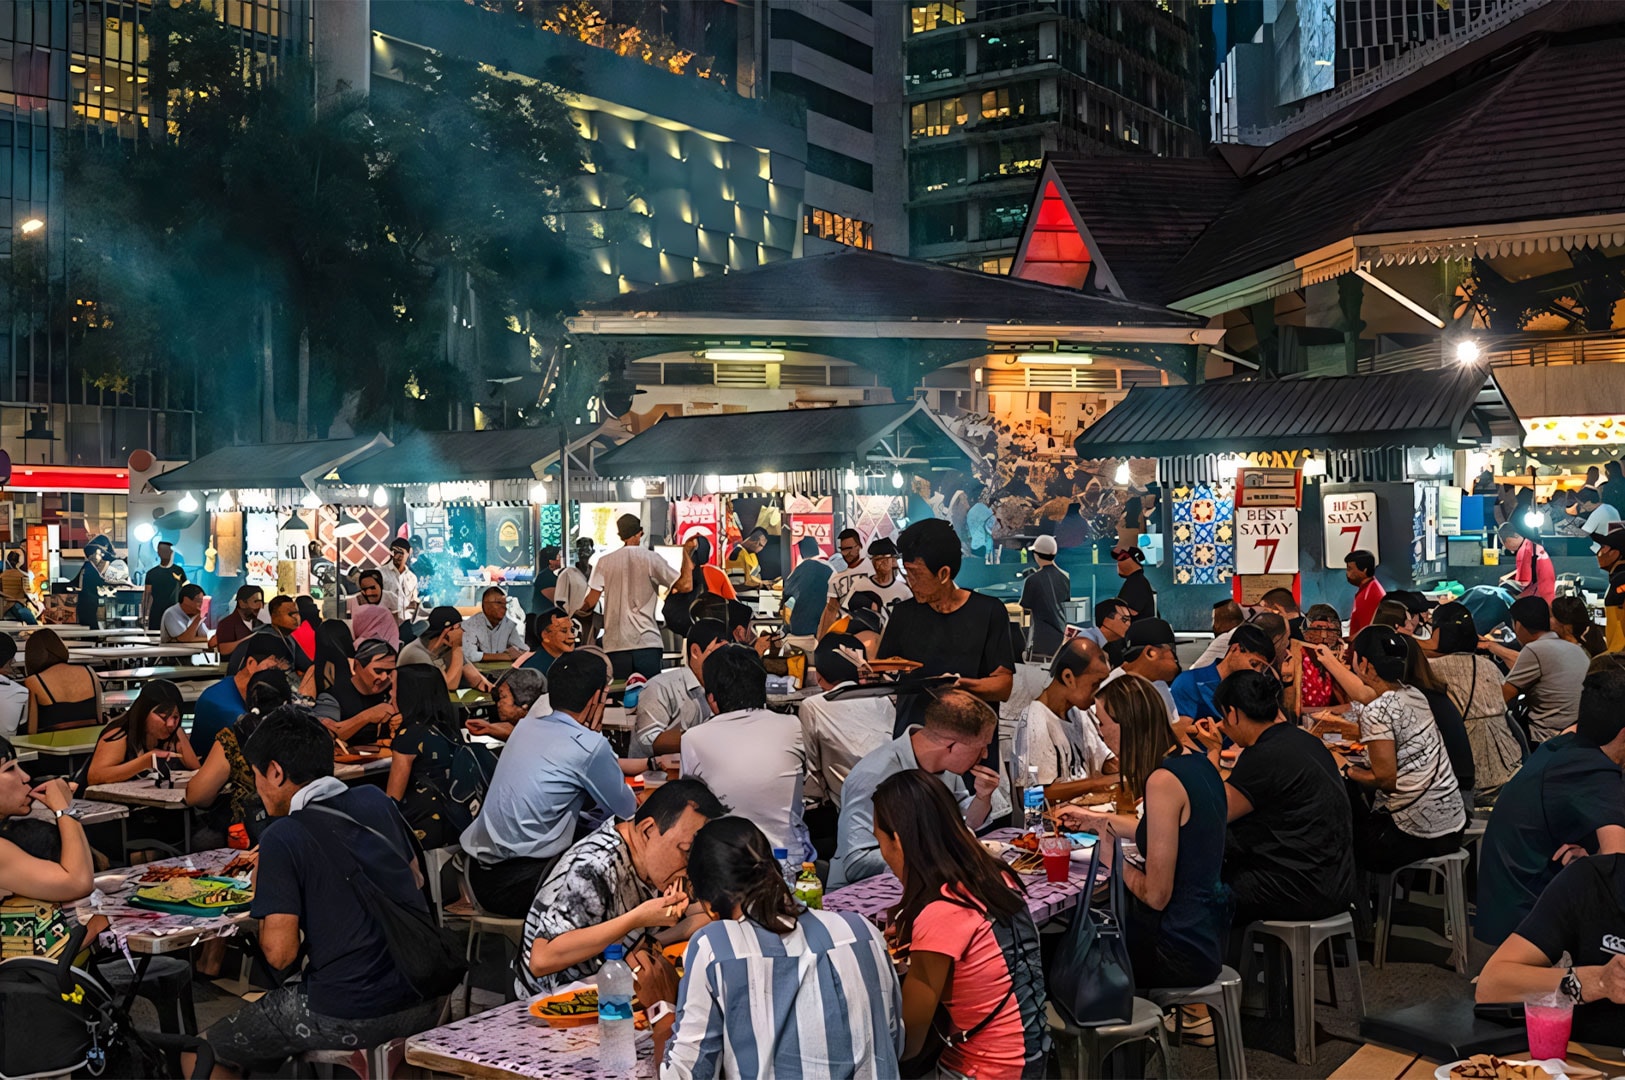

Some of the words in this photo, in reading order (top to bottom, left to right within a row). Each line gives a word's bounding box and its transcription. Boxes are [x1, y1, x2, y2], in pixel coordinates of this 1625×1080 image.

[1333, 499, 1367, 511] BEST
[1247, 509, 1286, 520] BEST
[1327, 511, 1372, 524] SATAY
[1240, 522, 1292, 535] SATAY
[1339, 526, 1362, 553] 7
[1253, 538, 1280, 574] 7
